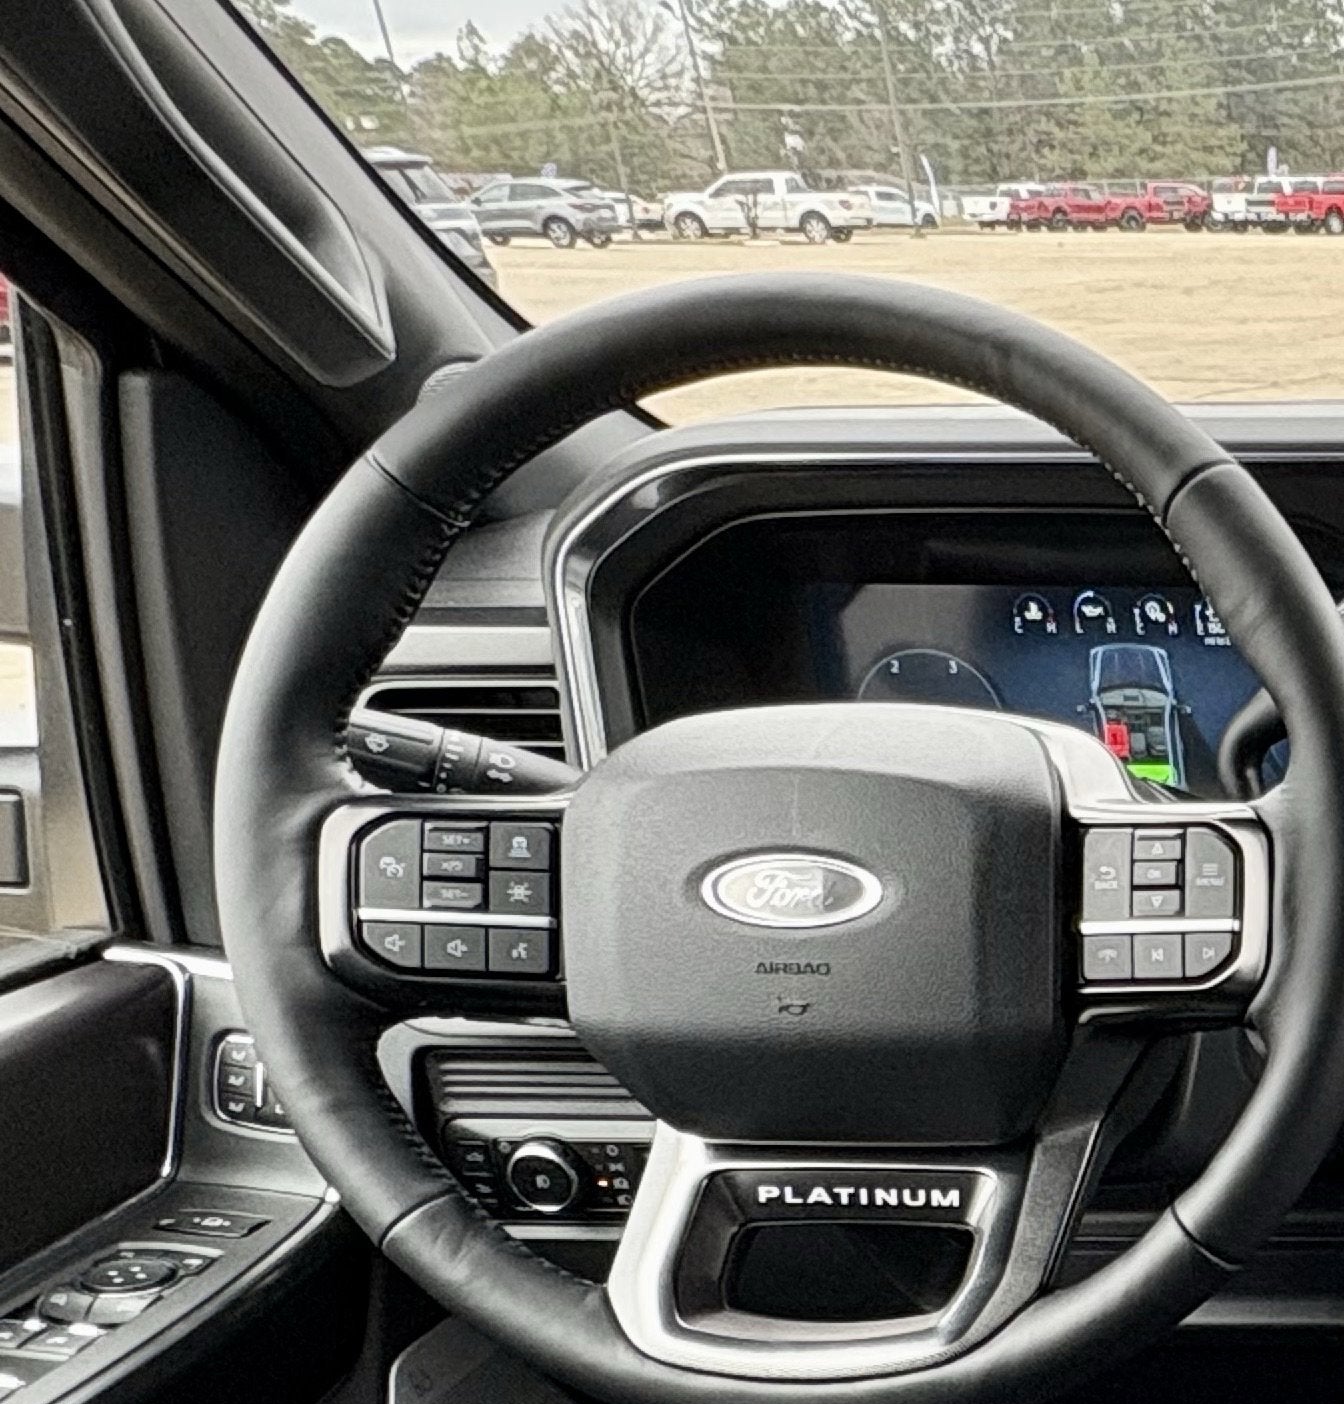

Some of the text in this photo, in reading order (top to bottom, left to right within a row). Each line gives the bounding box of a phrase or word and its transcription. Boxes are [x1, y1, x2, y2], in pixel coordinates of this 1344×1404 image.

[890, 660, 900, 674] 2
[746, 868, 835, 912] Ford
[755, 962, 832, 976] AIRBAG
[757, 1184, 960, 1208] PLATINUM
